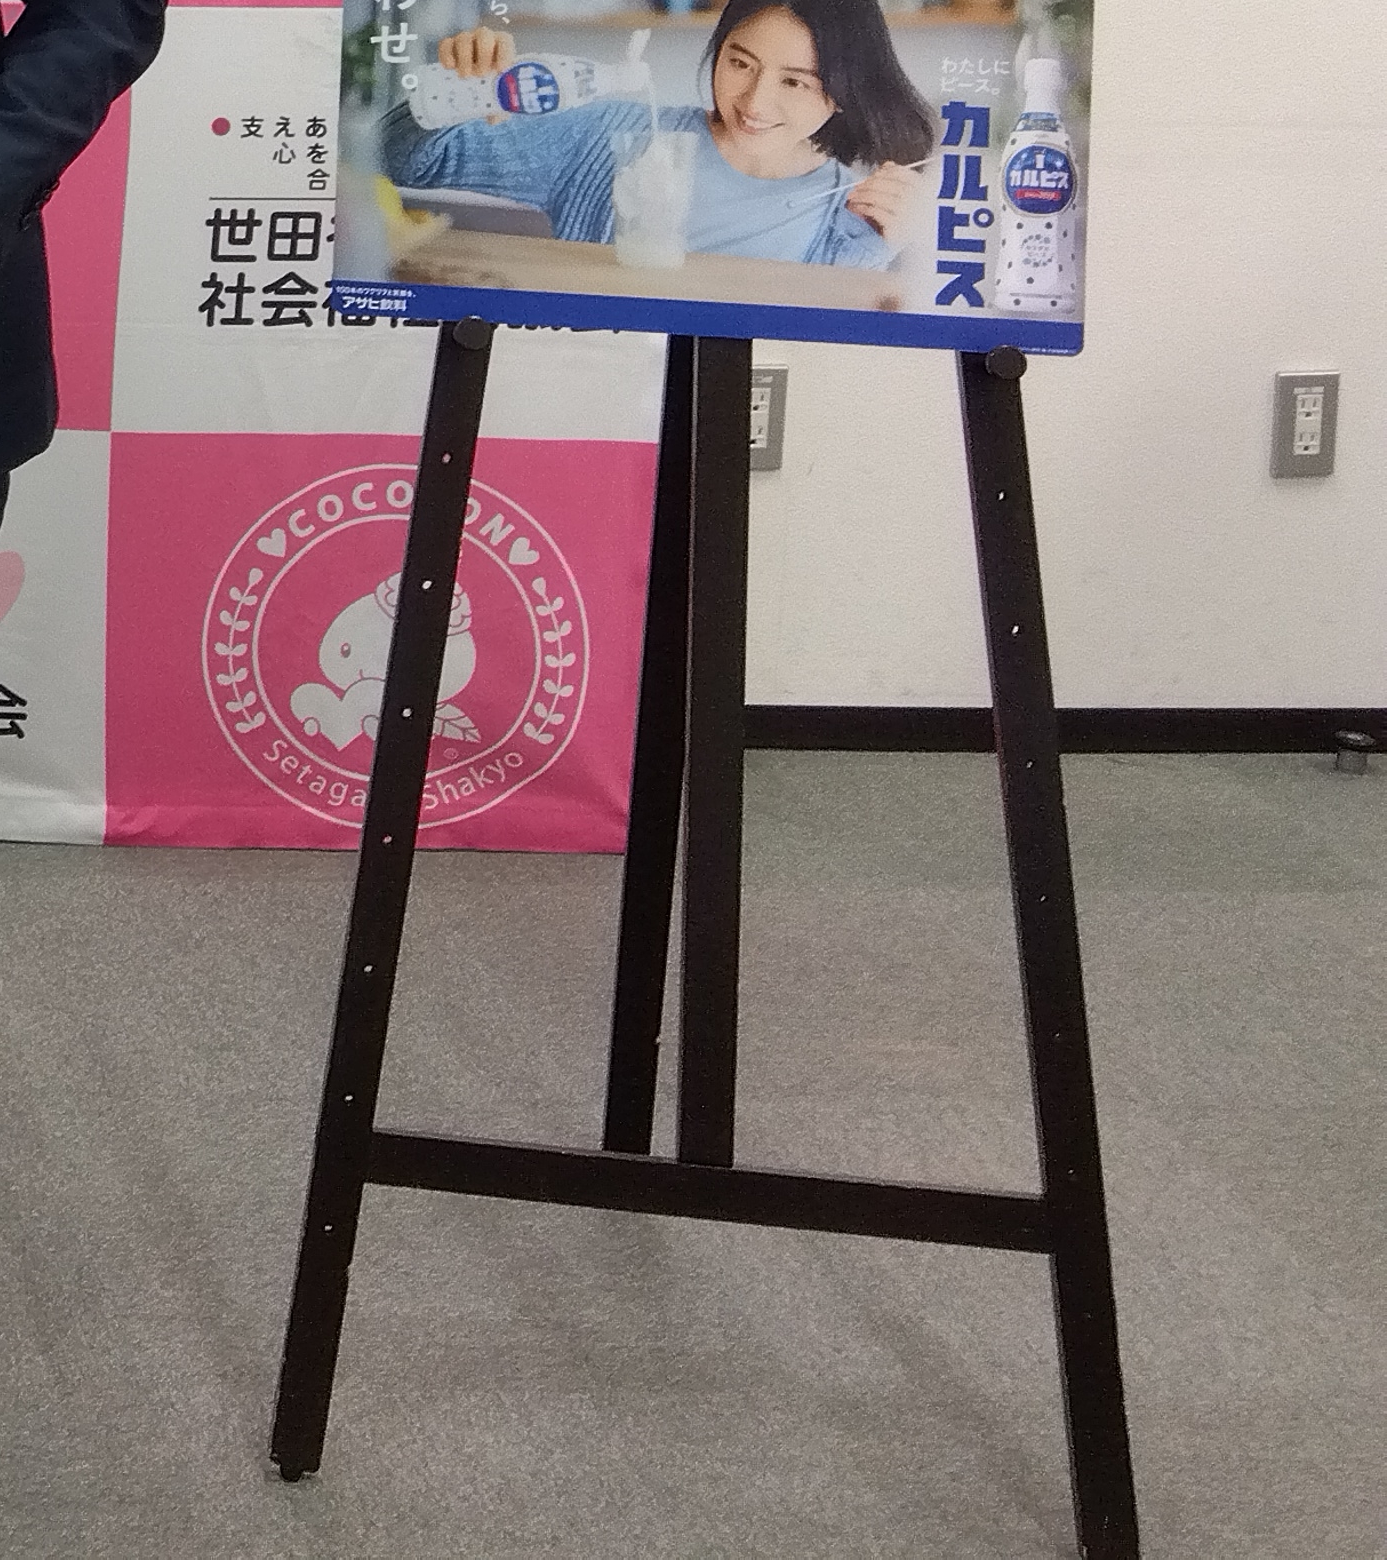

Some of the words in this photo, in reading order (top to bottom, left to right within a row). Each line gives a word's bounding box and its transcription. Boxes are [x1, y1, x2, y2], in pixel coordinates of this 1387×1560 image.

[204, 207, 336, 263] 世田
[934, 100, 995, 308] カルピス
[341, 295, 407, 312] アサヒ飲料
[288, 478, 515, 547] COCOON
